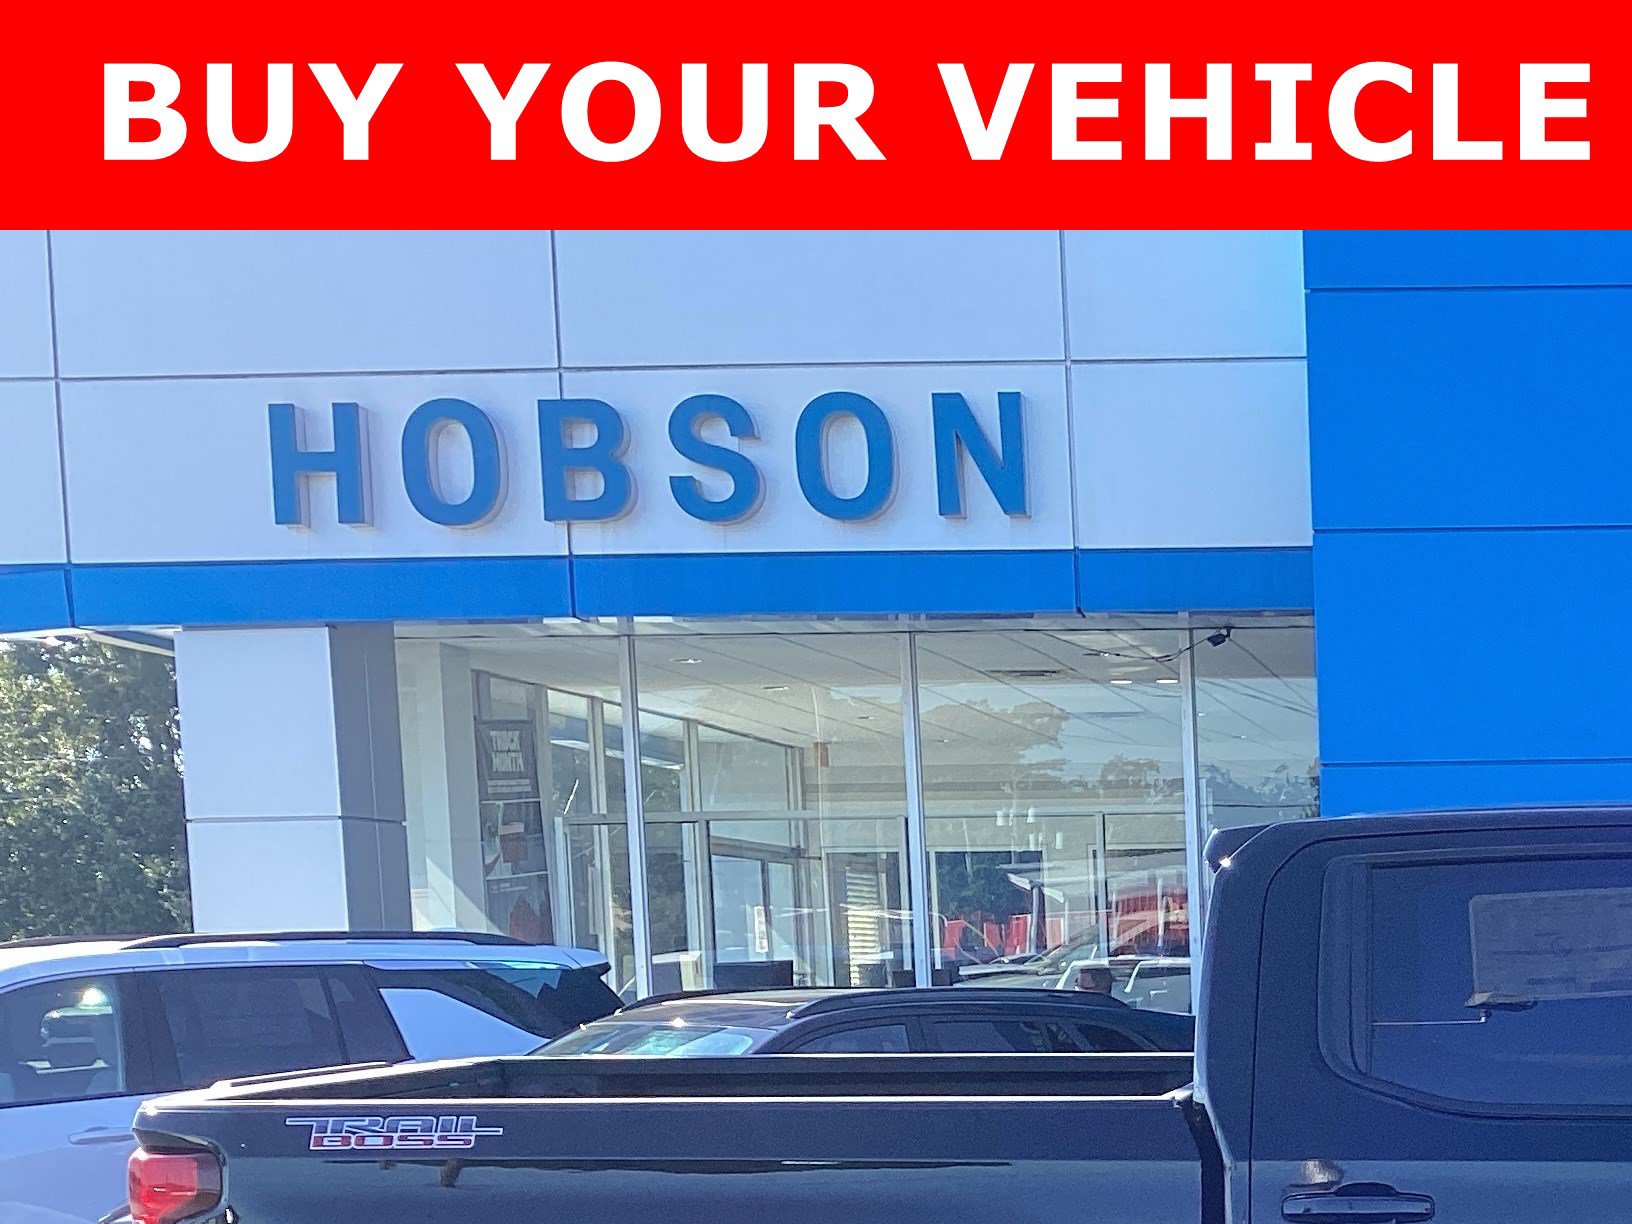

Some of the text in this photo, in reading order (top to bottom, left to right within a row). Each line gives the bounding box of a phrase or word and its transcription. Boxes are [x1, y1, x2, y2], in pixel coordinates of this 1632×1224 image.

[268, 390, 1032, 526] HOBSON
[285, 1116, 503, 1136] TRAIL
[310, 1134, 477, 1151] BOSS
